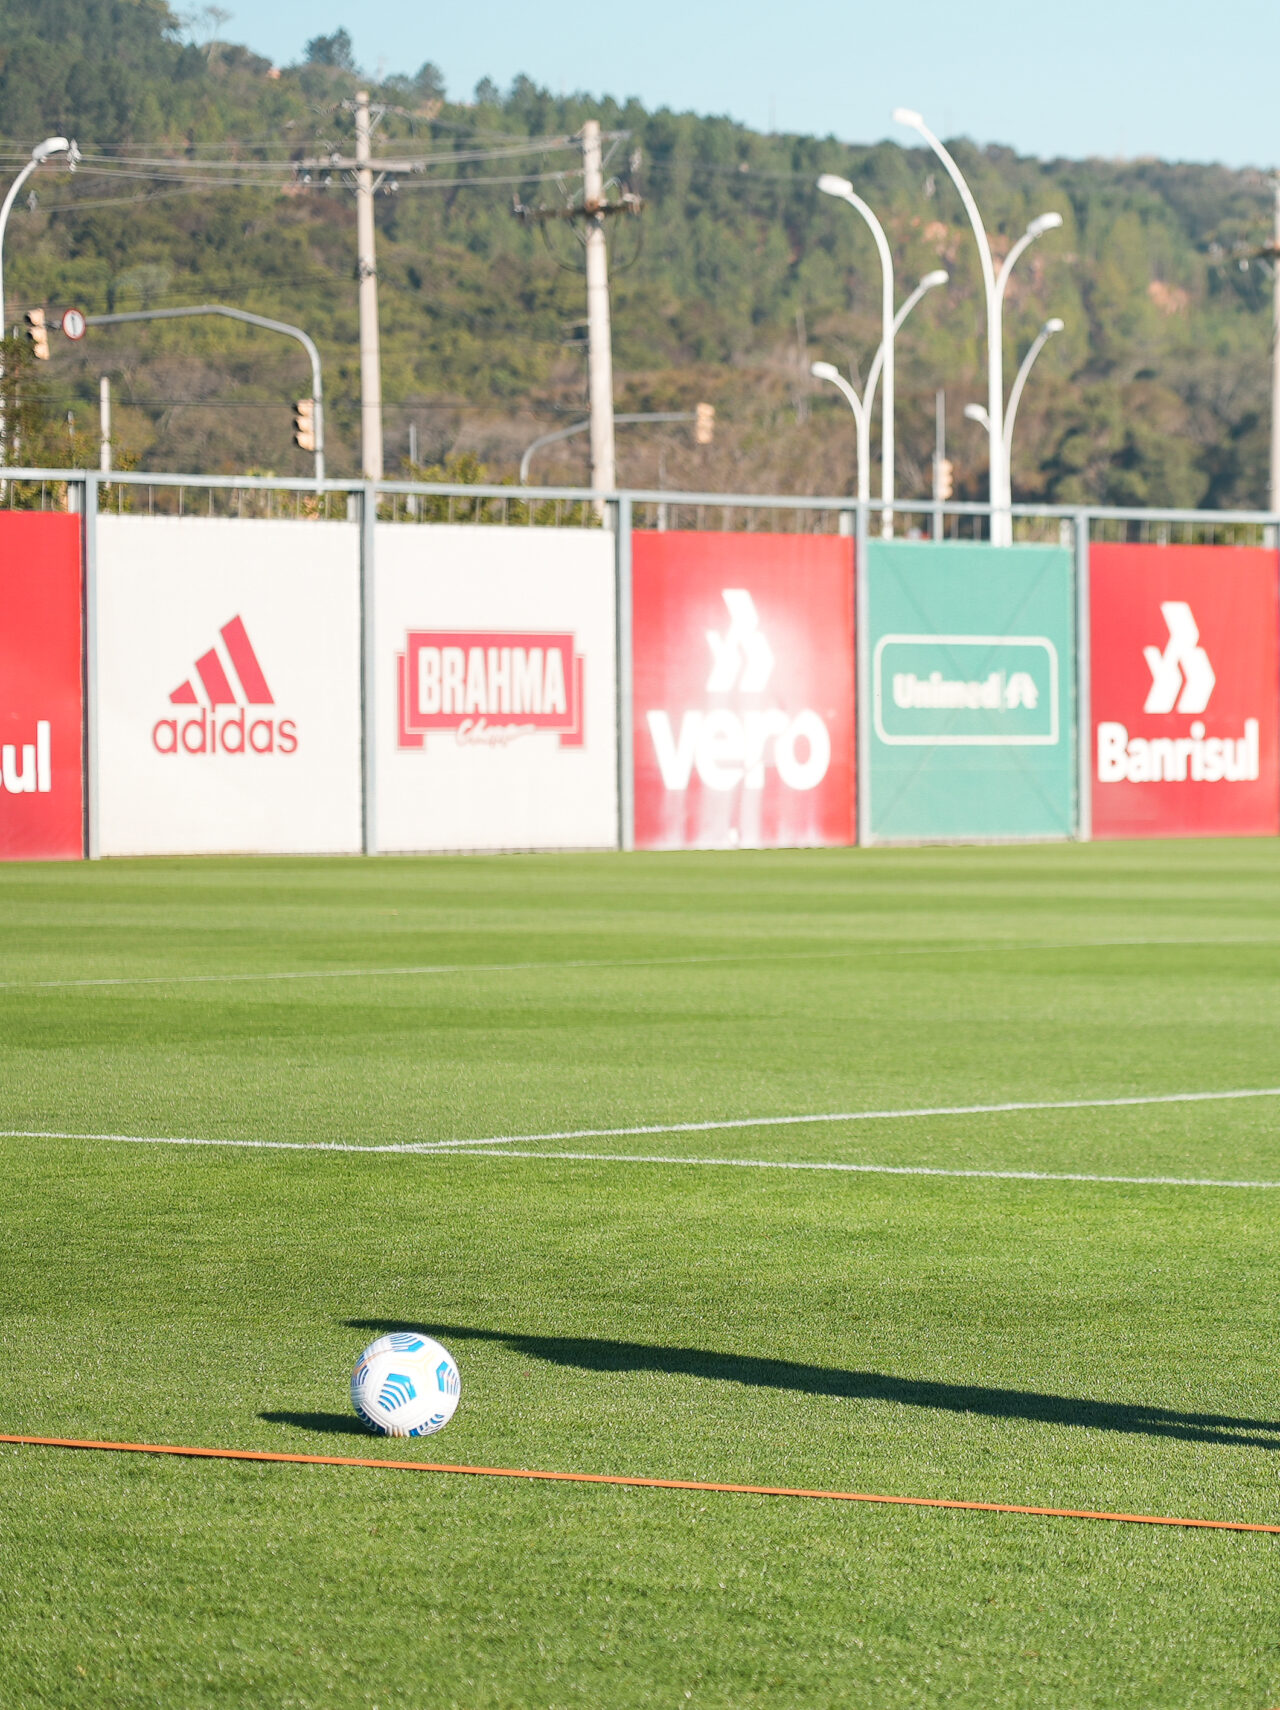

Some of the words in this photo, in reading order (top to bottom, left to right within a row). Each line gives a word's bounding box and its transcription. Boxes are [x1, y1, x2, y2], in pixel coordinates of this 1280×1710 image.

[418, 646, 567, 714] BRAHMA
[0, 720, 51, 793] ul
[153, 707, 298, 753] adidas
[646, 708, 831, 790] vero
[1097, 717, 1259, 783] Banrisul
